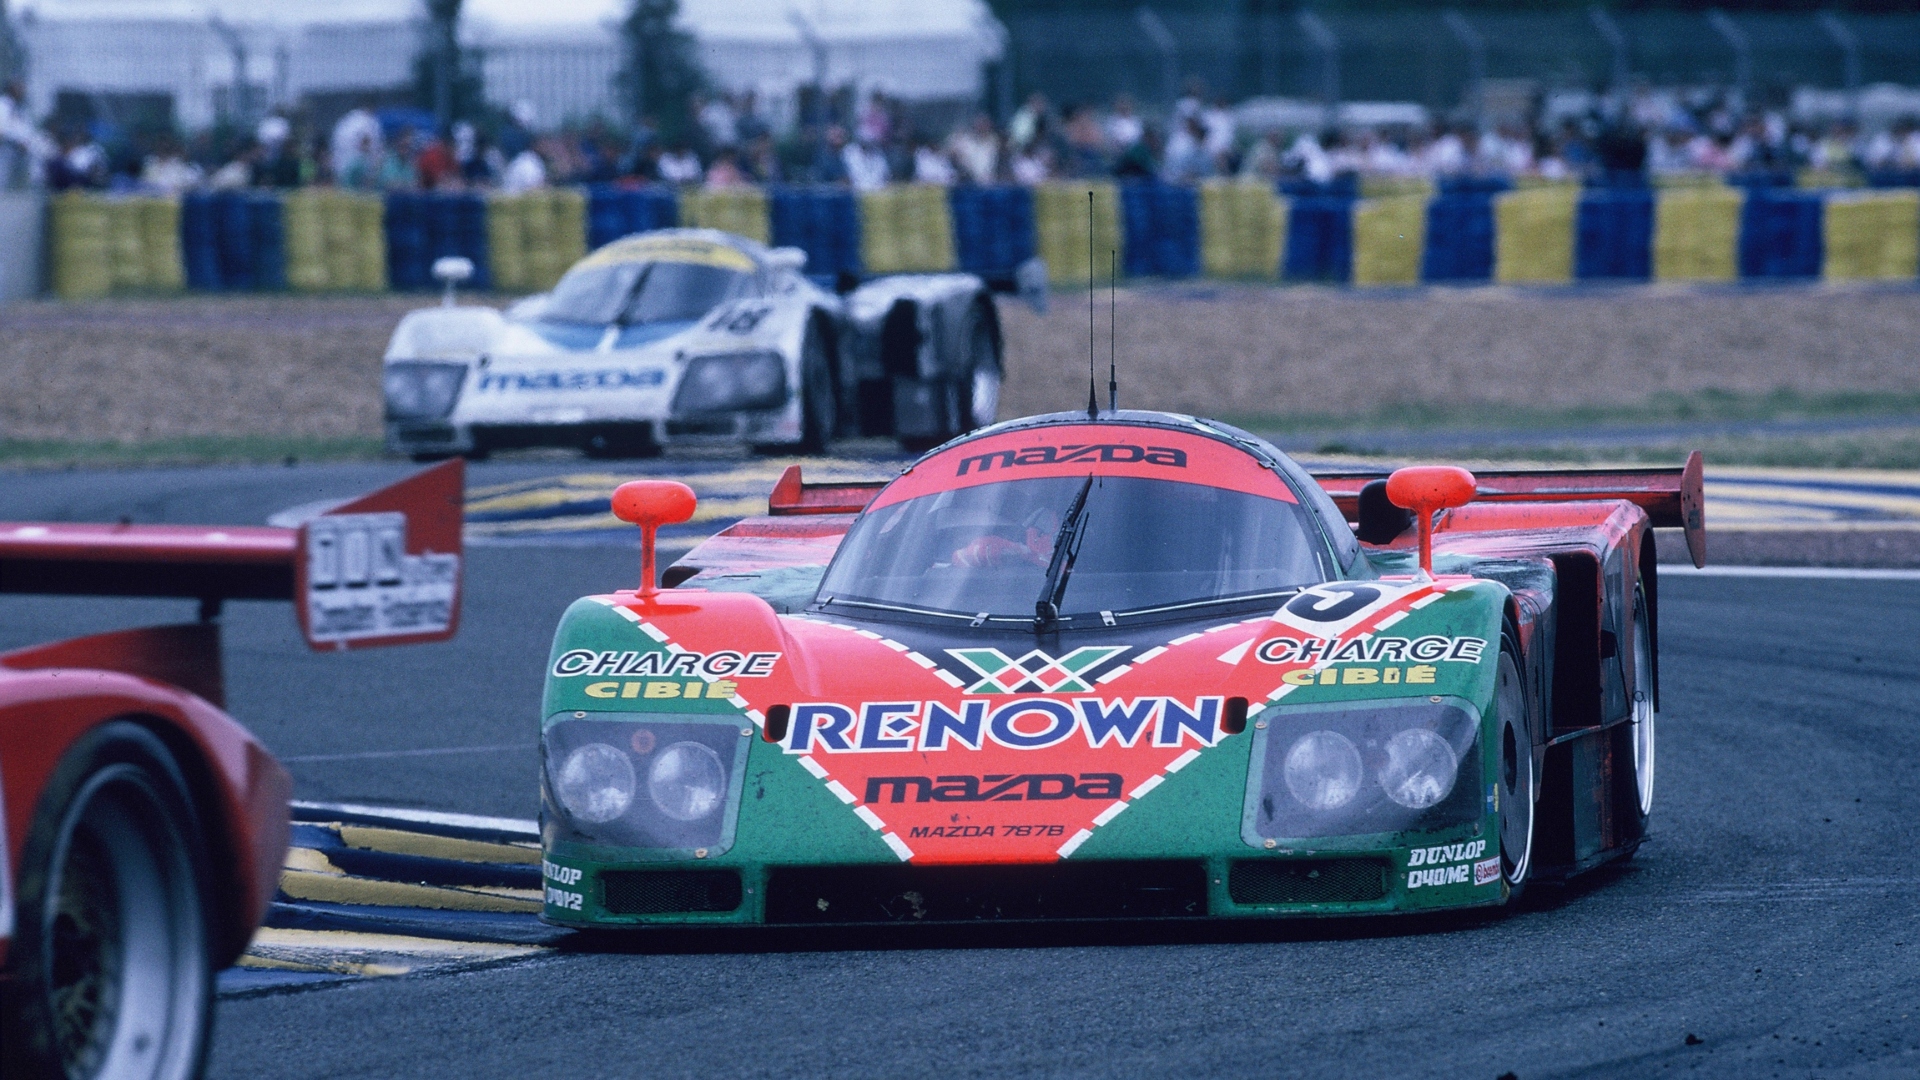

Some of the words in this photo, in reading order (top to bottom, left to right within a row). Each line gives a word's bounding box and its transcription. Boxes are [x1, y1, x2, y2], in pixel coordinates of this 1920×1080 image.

[956, 444, 1187, 476] mazda
[553, 649, 783, 677] CHARGE
[1255, 635, 1488, 665] CHARGE
[1281, 664, 1437, 686] CIBIÉ
[584, 680, 738, 699] CIBIÉ
[783, 696, 1225, 754] RENOWN
[864, 773, 1123, 803] mazda
[909, 825, 995, 838] MAZDA
[1002, 825, 1065, 837] 787B
[1408, 840, 1486, 867] DUNLOP
[1407, 864, 1469, 888] D40/M2
